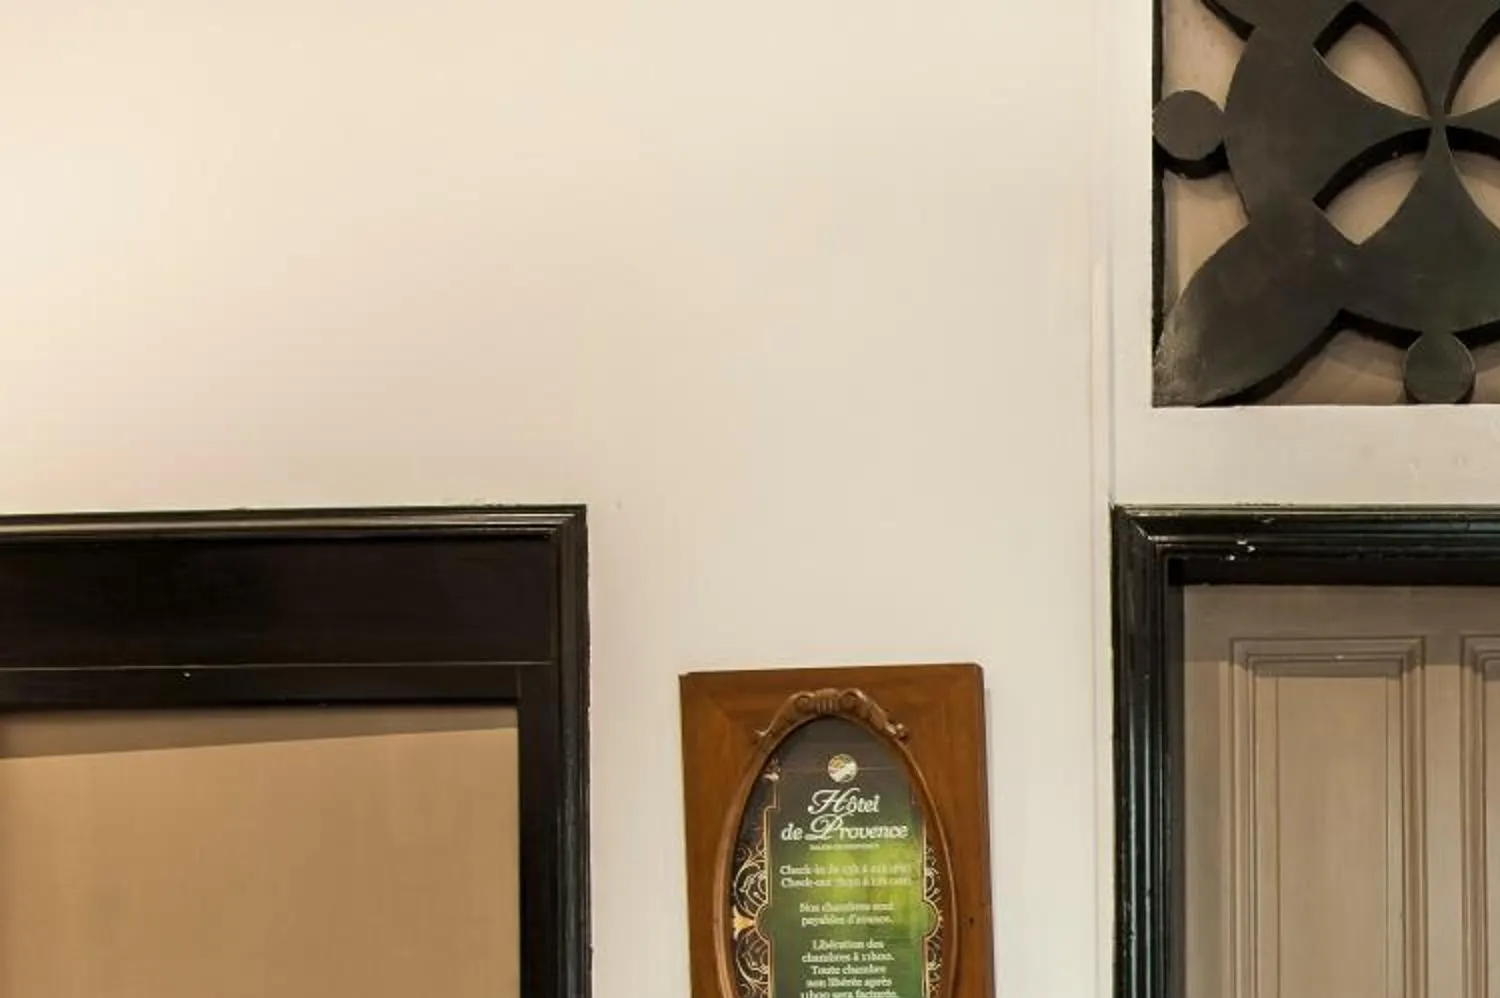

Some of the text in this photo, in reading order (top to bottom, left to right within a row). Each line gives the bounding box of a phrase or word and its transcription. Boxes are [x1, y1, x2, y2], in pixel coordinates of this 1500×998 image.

[807, 787, 881, 815] Hôtel
[781, 813, 909, 841] de Provence
